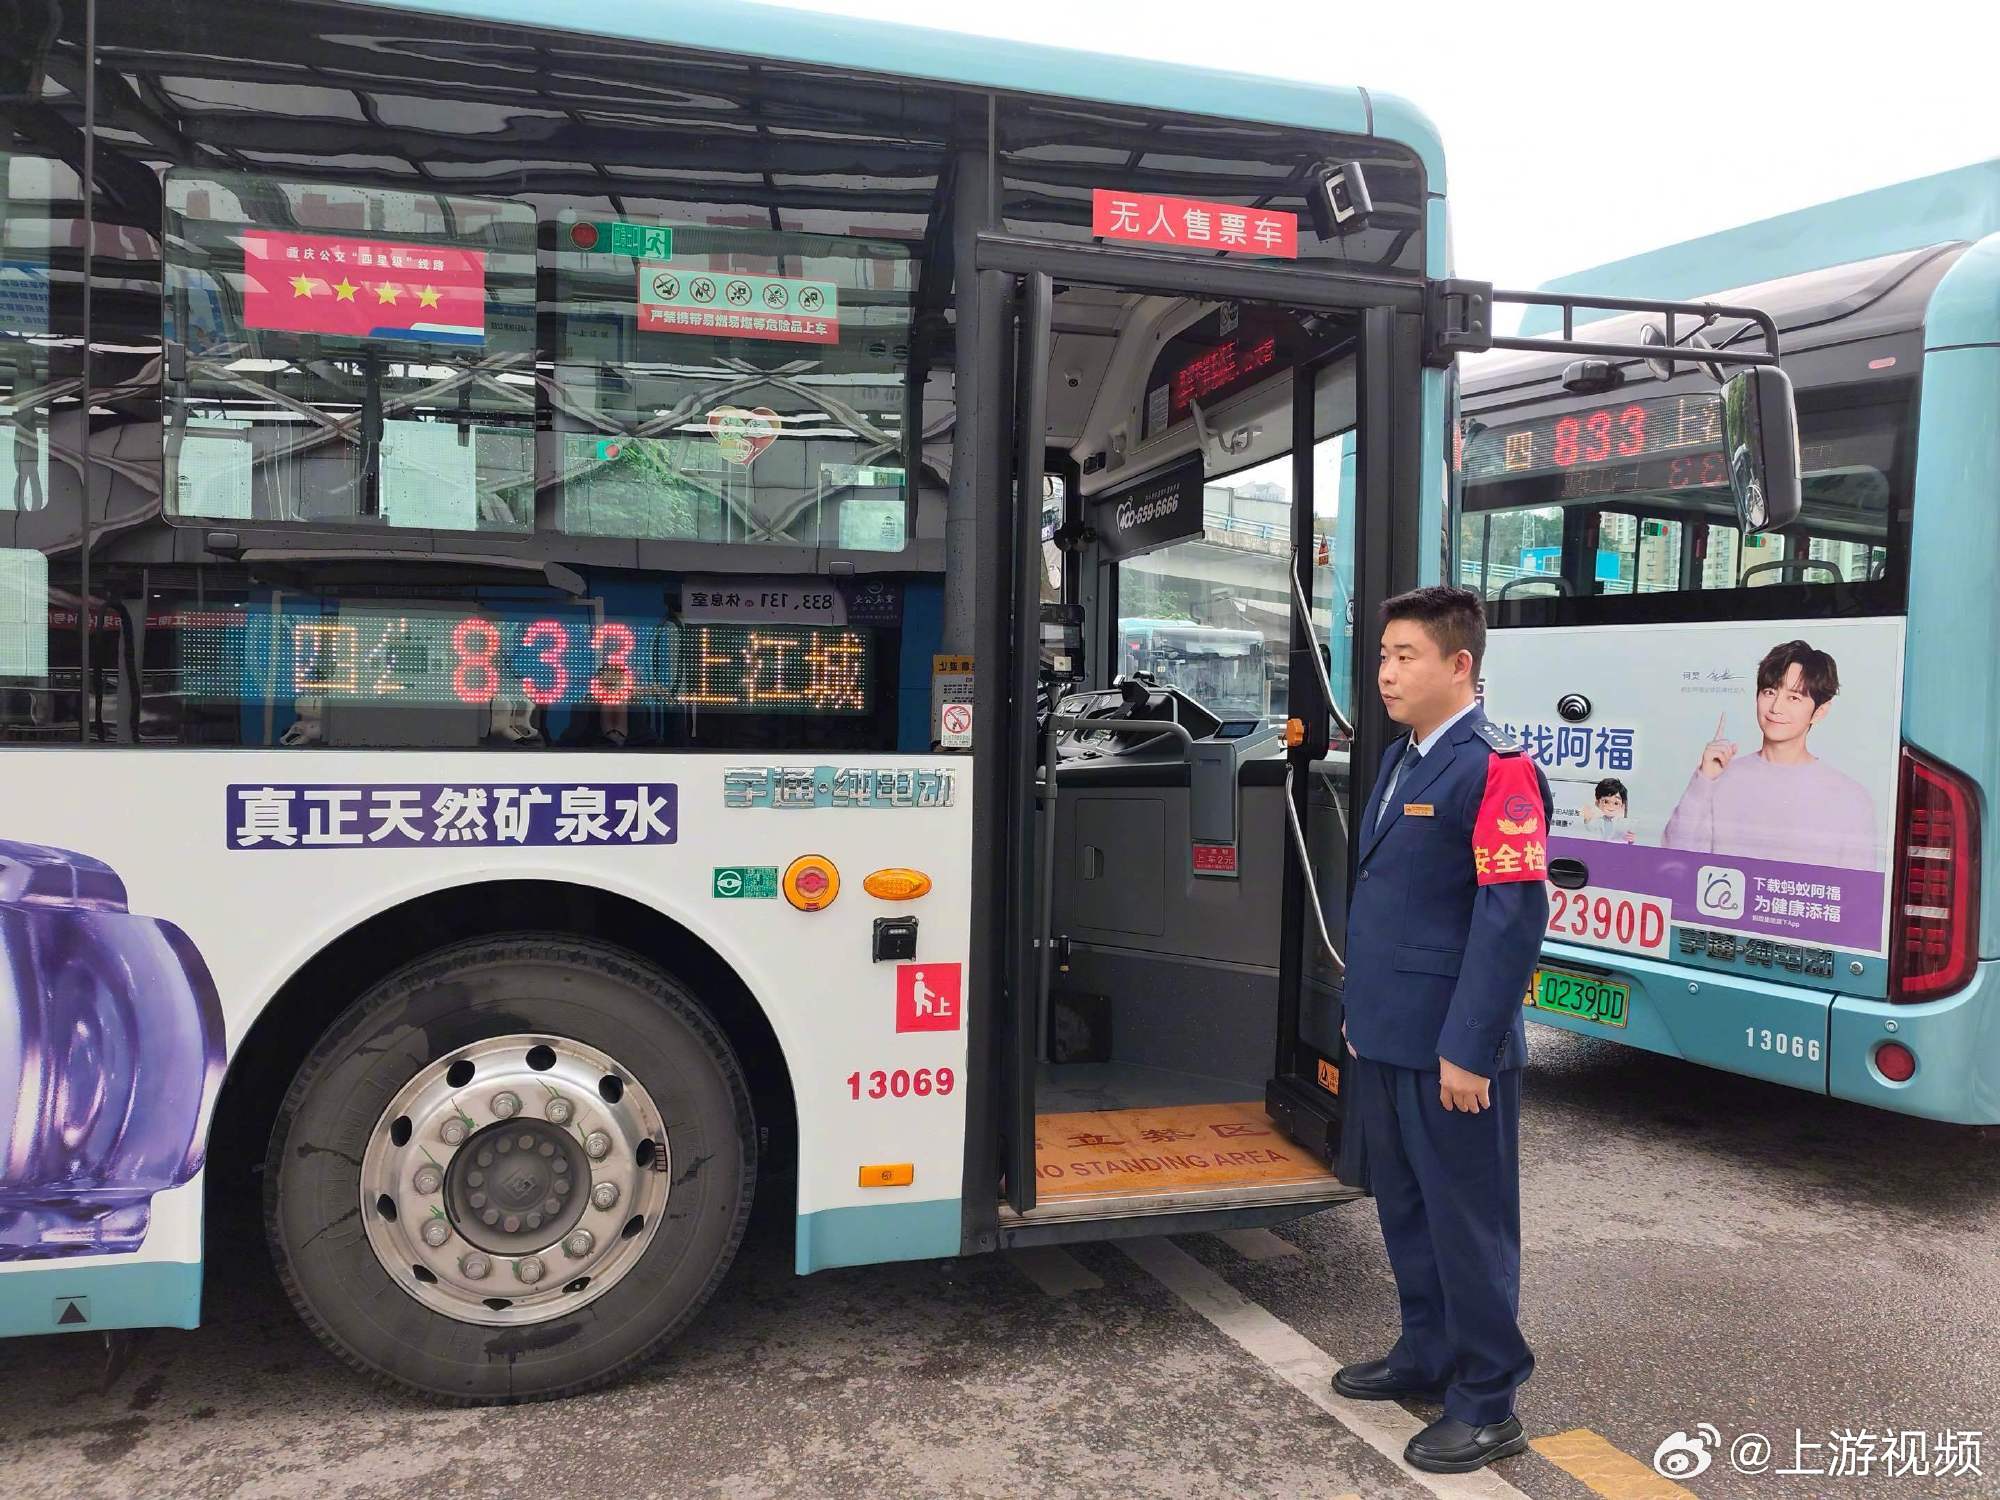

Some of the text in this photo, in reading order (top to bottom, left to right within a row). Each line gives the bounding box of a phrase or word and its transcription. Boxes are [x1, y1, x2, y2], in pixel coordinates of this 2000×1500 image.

[1109, 200, 1282, 249] 无人售票车
[1552, 404, 1645, 466] 833
[452, 618, 637, 704] 833
[678, 628, 866, 708] 上江城
[237, 787, 671, 847] 真正天然矿泉水
[1753, 876, 1841, 901] 下载蚂蚁阿福
[1754, 895, 1841, 923] 为健康添福
[1549, 890, 1664, 948] 2390D
[1546, 977, 1624, 1019] 02390D
[1745, 1027, 1820, 1061] 13066
[847, 1067, 954, 1101] 13069
[1036, 1123, 1272, 1150] 立禁区
[1070, 1154, 1209, 1177] STANDING
[1215, 1149, 1289, 1167] AREA
